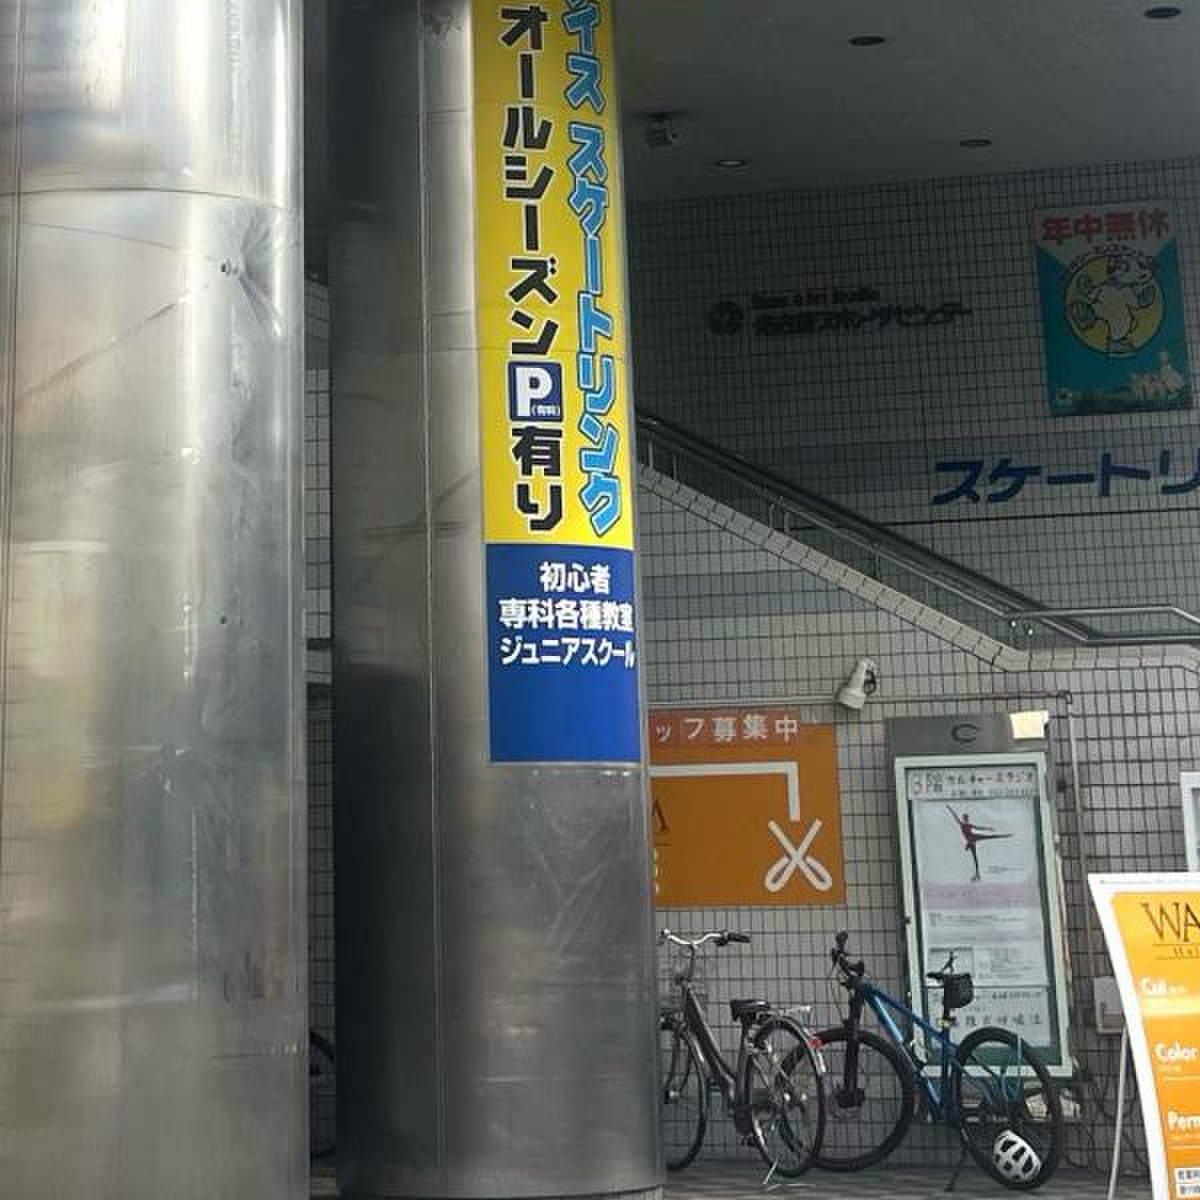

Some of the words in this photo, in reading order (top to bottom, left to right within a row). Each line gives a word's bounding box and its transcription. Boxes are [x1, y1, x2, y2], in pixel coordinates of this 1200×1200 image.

[539, 561, 611, 594] 初心者
[500, 635, 635, 669] ジュニアスクール
[1155, 1041, 1198, 1063] Color
